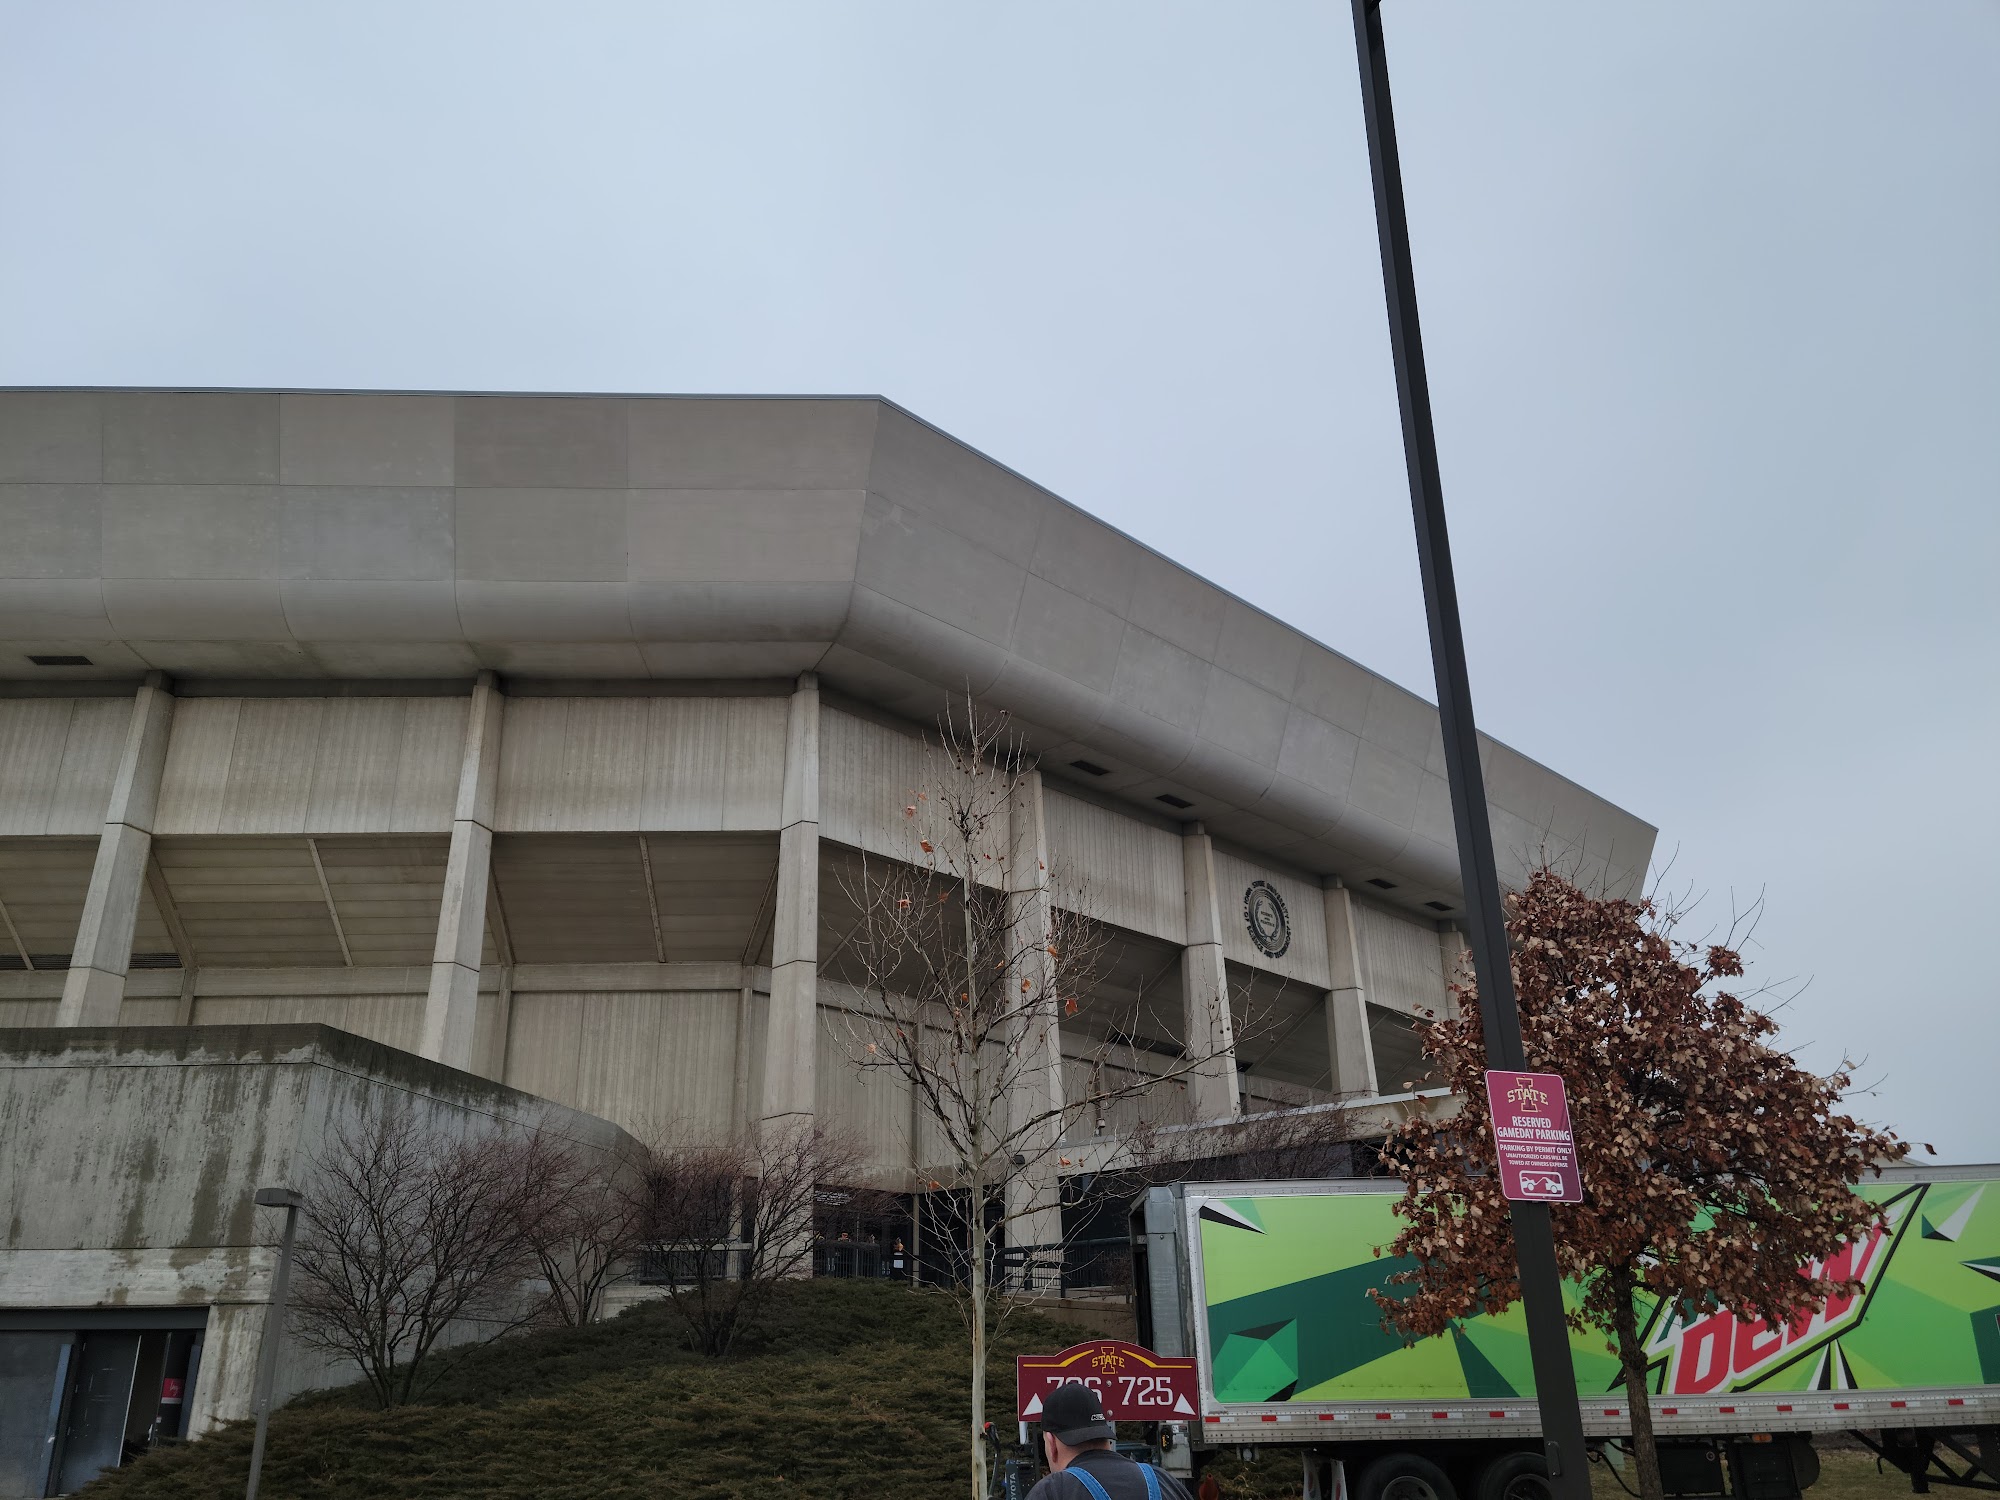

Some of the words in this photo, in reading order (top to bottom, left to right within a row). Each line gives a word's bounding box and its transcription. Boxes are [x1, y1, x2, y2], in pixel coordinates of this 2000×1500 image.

[1507, 1088, 1549, 1105] STATE
[1511, 1116, 1551, 1128] RESERVED
[1497, 1127, 1534, 1139] GAMEDAY
[1535, 1129, 1571, 1141] PARKING
[1500, 1144, 1525, 1152] PARKING
[1091, 1355, 1125, 1368] STATE
[1118, 1376, 1174, 1406] 725
